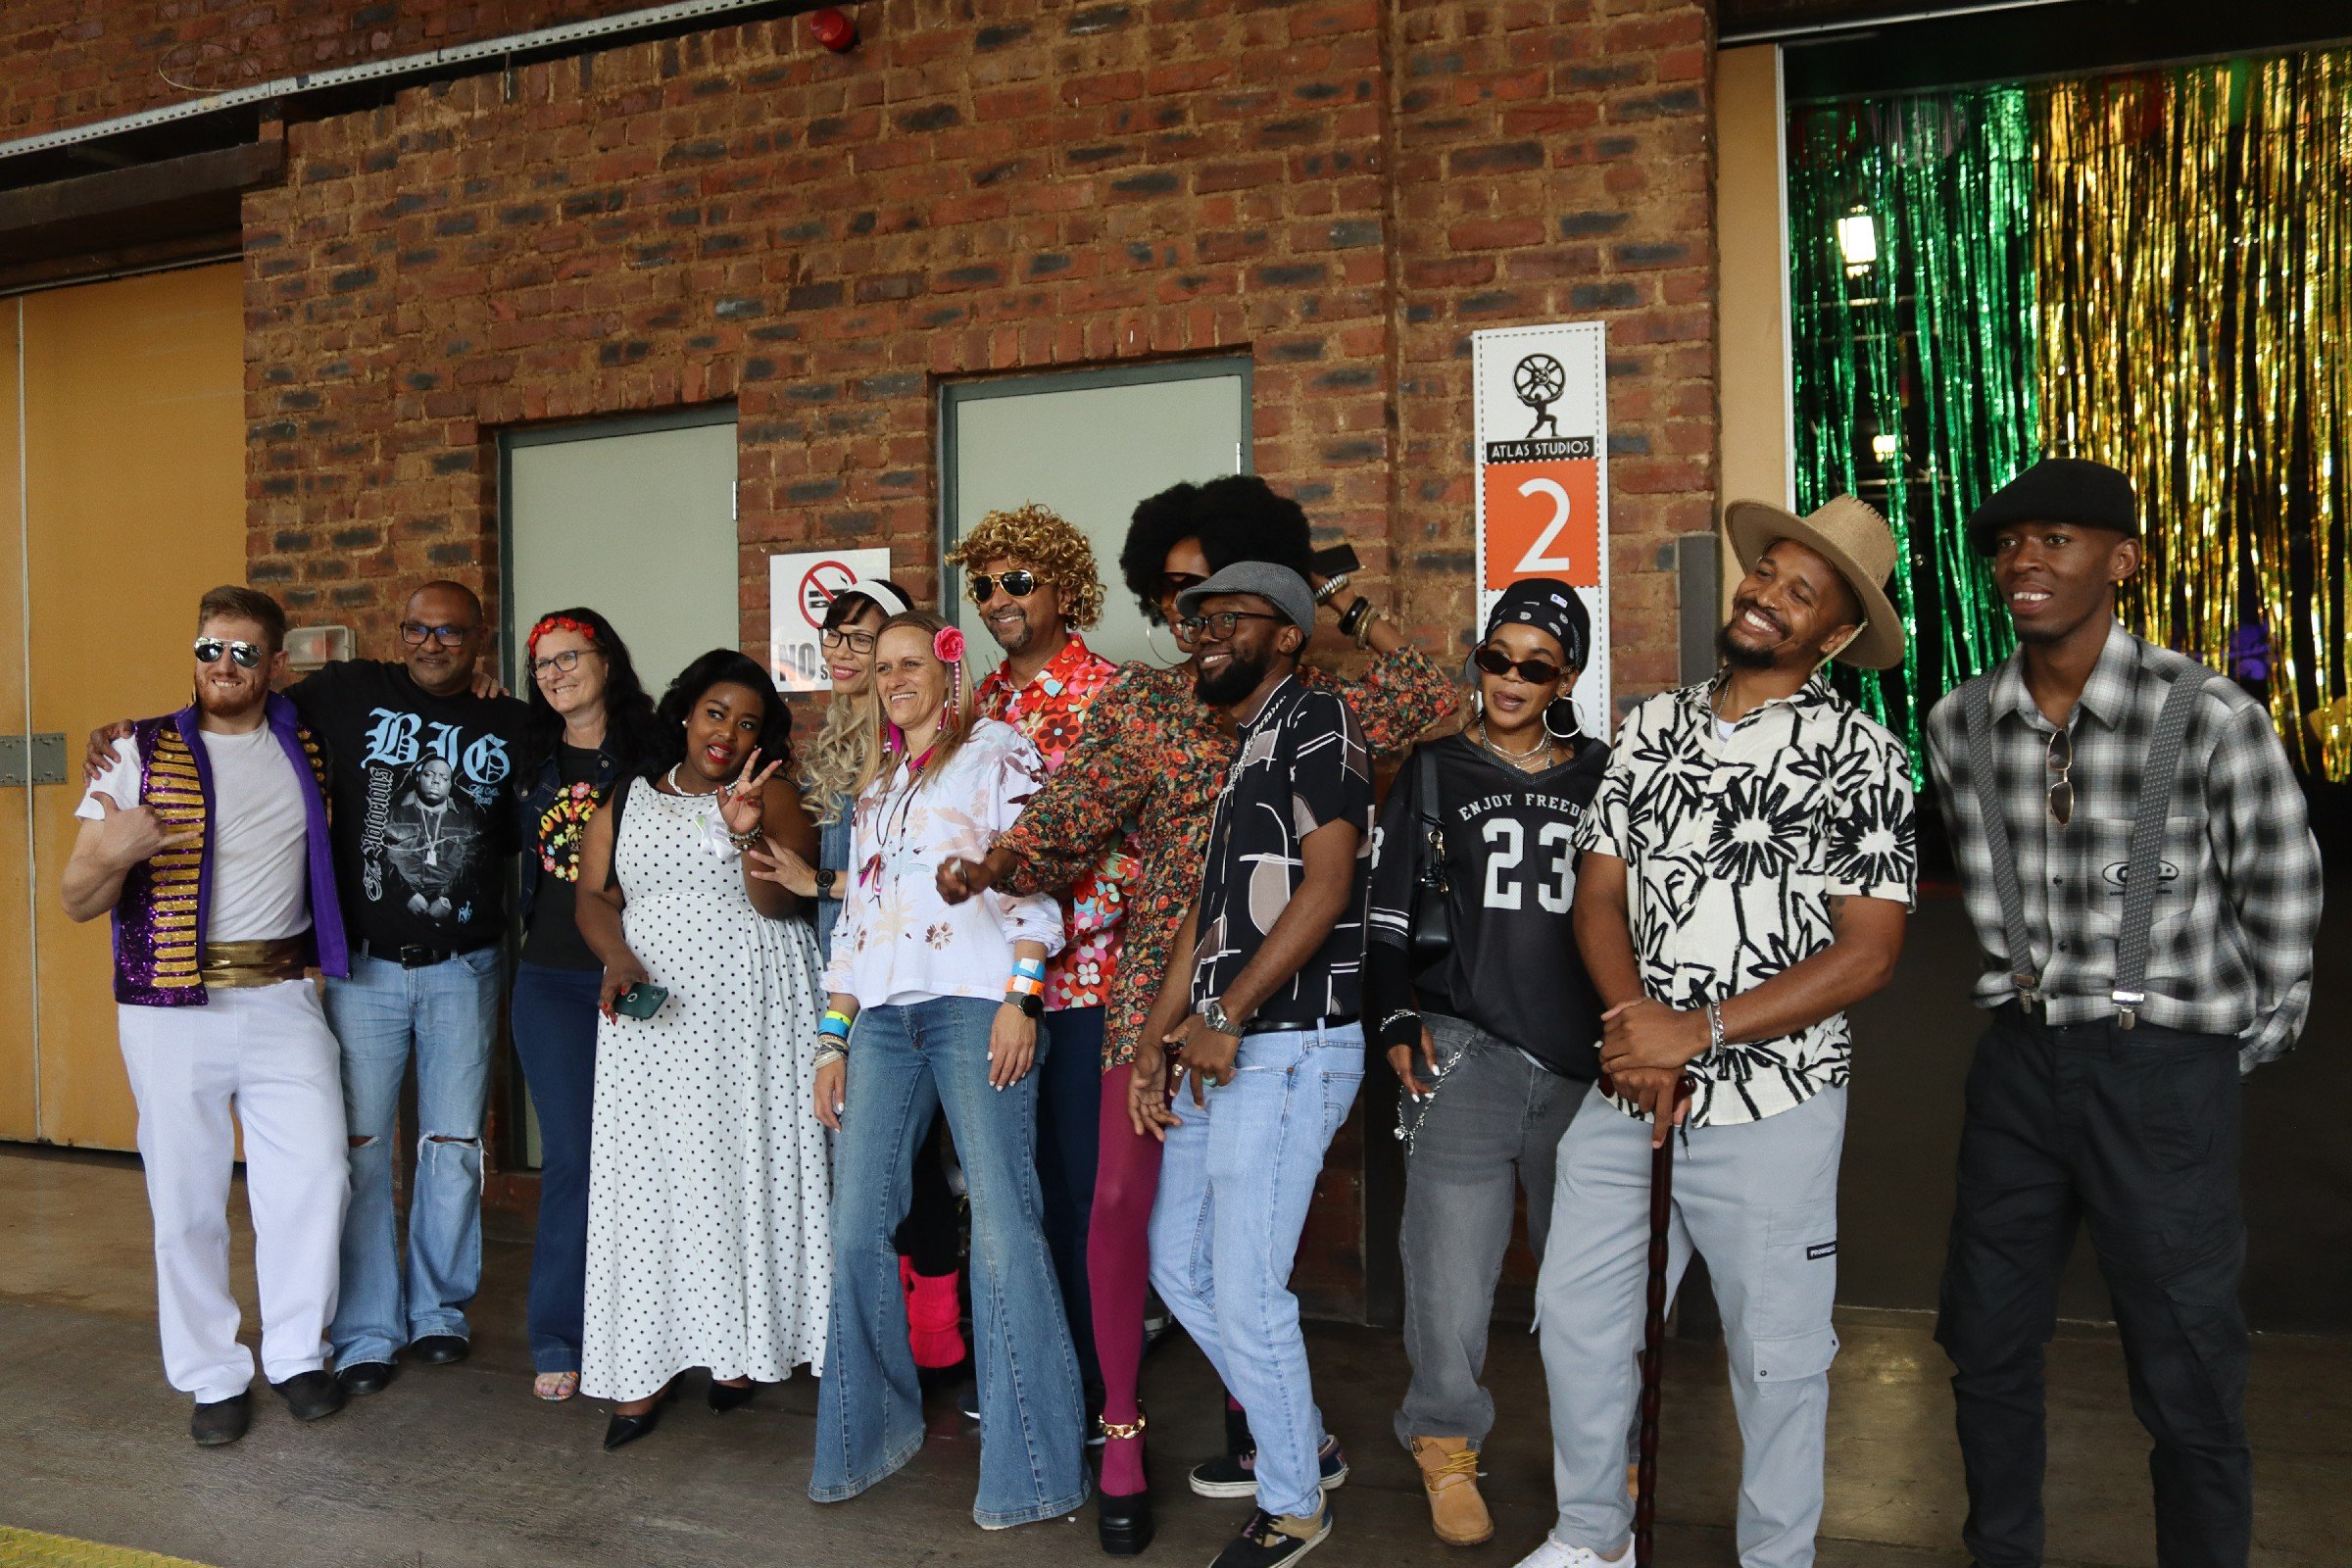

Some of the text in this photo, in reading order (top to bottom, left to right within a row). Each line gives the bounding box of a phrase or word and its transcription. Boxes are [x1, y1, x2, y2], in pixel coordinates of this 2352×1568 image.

[1492, 440, 1590, 458] ATLAS STUDIOS
[1513, 477, 1571, 573] 2
[779, 643, 816, 681] NO
[361, 707, 511, 784] BIG
[1458, 794, 1513, 821] ENJOY
[1482, 817, 1577, 914] 23
